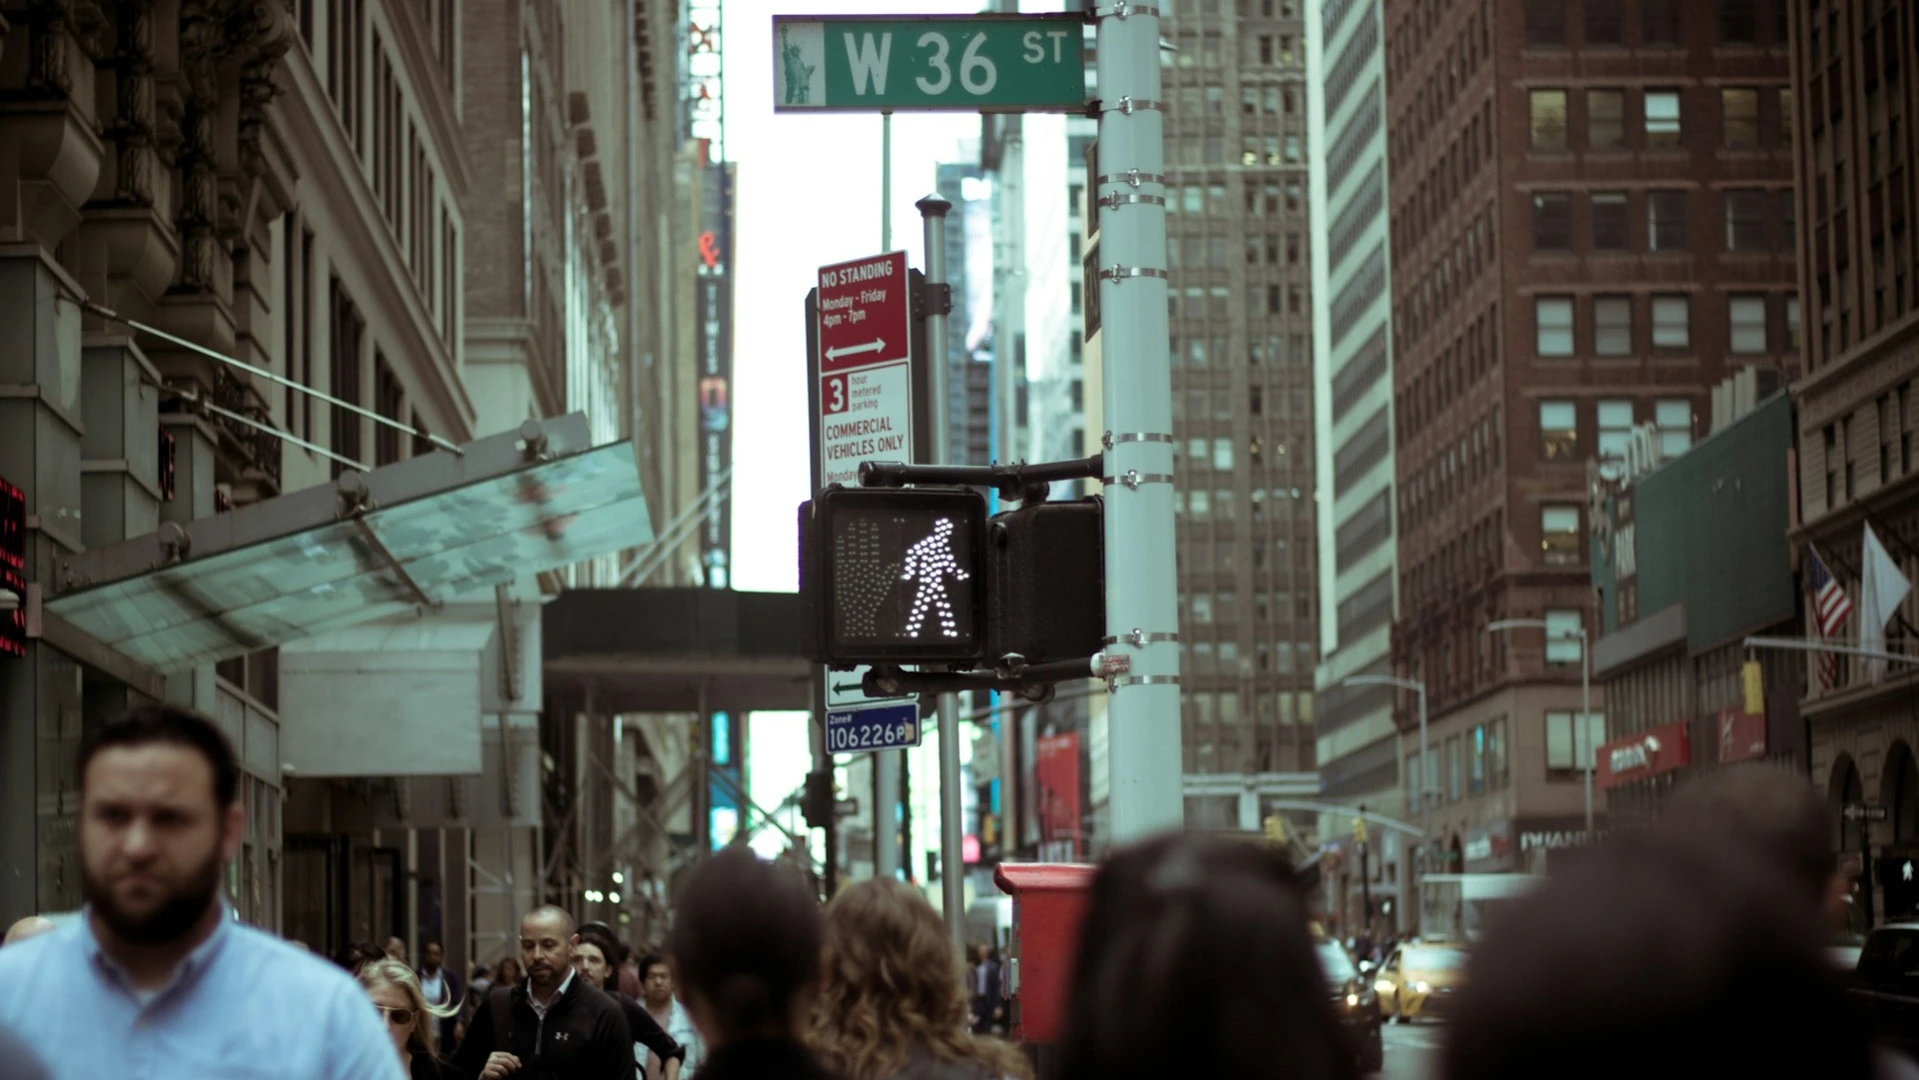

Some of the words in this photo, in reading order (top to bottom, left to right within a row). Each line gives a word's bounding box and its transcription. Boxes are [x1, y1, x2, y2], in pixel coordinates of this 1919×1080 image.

[843, 31, 893, 96] W
[915, 30, 998, 96] 36
[1022, 30, 1069, 65] ST
[822, 271, 837, 288] NO
[839, 260, 893, 285] STANDING
[822, 295, 854, 312] Monday
[861, 289, 887, 304] Friday
[823, 314, 842, 329] 4pm
[848, 309, 866, 324] 7pm
[851, 375, 867, 385] hour
[852, 385, 881, 398] metered
[829, 378, 844, 412] 3
[852, 400, 878, 412] parking
[826, 416, 893, 440] COMMERCIAL
[826, 439, 876, 460] VEHICLES
[877, 433, 904, 453] ONLY
[830, 723, 895, 750] 106226
